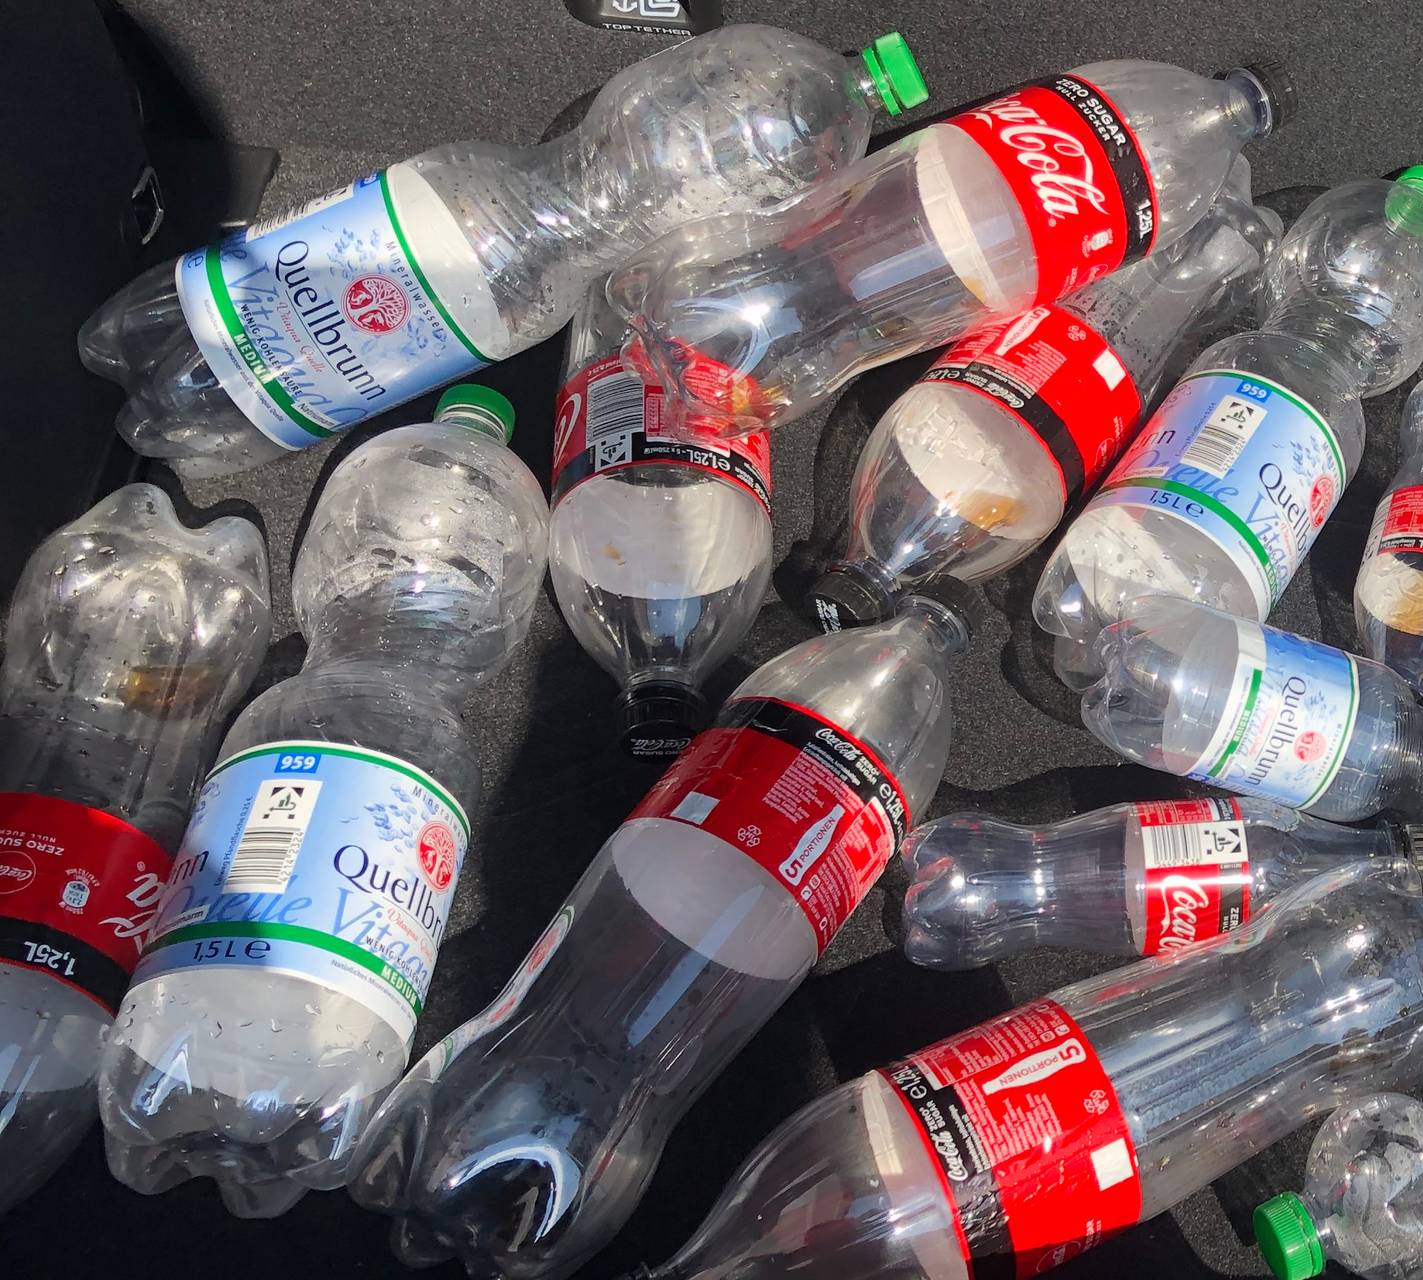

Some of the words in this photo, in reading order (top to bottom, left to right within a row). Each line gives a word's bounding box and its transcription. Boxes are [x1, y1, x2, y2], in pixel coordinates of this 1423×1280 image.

[1055, 85, 1077, 102] NULL
[1078, 102, 1109, 142] ZUCKER
[1056, 77, 1089, 98] ZERO
[1087, 96, 1127, 147] SUGAR
[1135, 199, 1154, 239] 1,25L
[385, 241, 446, 341] Mineralwasser
[240, 303, 259, 337] WENIG
[274, 240, 388, 401] Quellbrunn
[278, 301, 302, 342] Vitaqua
[299, 344, 323, 374] Quelle
[234, 332, 278, 386] MEDIUM
[980, 380, 1024, 409] Coca-Cola
[1240, 382, 1268, 400] 959
[631, 736, 692, 751] Coca-Cola
[815, 727, 862, 762] Coca-Cola
[1245, 676, 1306, 786] Quellbrunn
[279, 755, 316, 770] 959
[856, 762, 877, 785] SUGAR
[26, 839, 65, 856] ZERO
[35, 832, 56, 843] NULL
[785, 859, 803, 879] 5
[800, 817, 836, 862] PORTIONEN
[24, 941, 76, 976] 1,25L
[365, 936, 395, 962] WENIG
[381, 964, 419, 1008] MEDIUM
[999, 1055, 1059, 1086] PORTIONEN
[1059, 1045, 1081, 1062] 5
[926, 1100, 945, 1129] SUGAR
[933, 1130, 969, 1182] Coca-Cola
